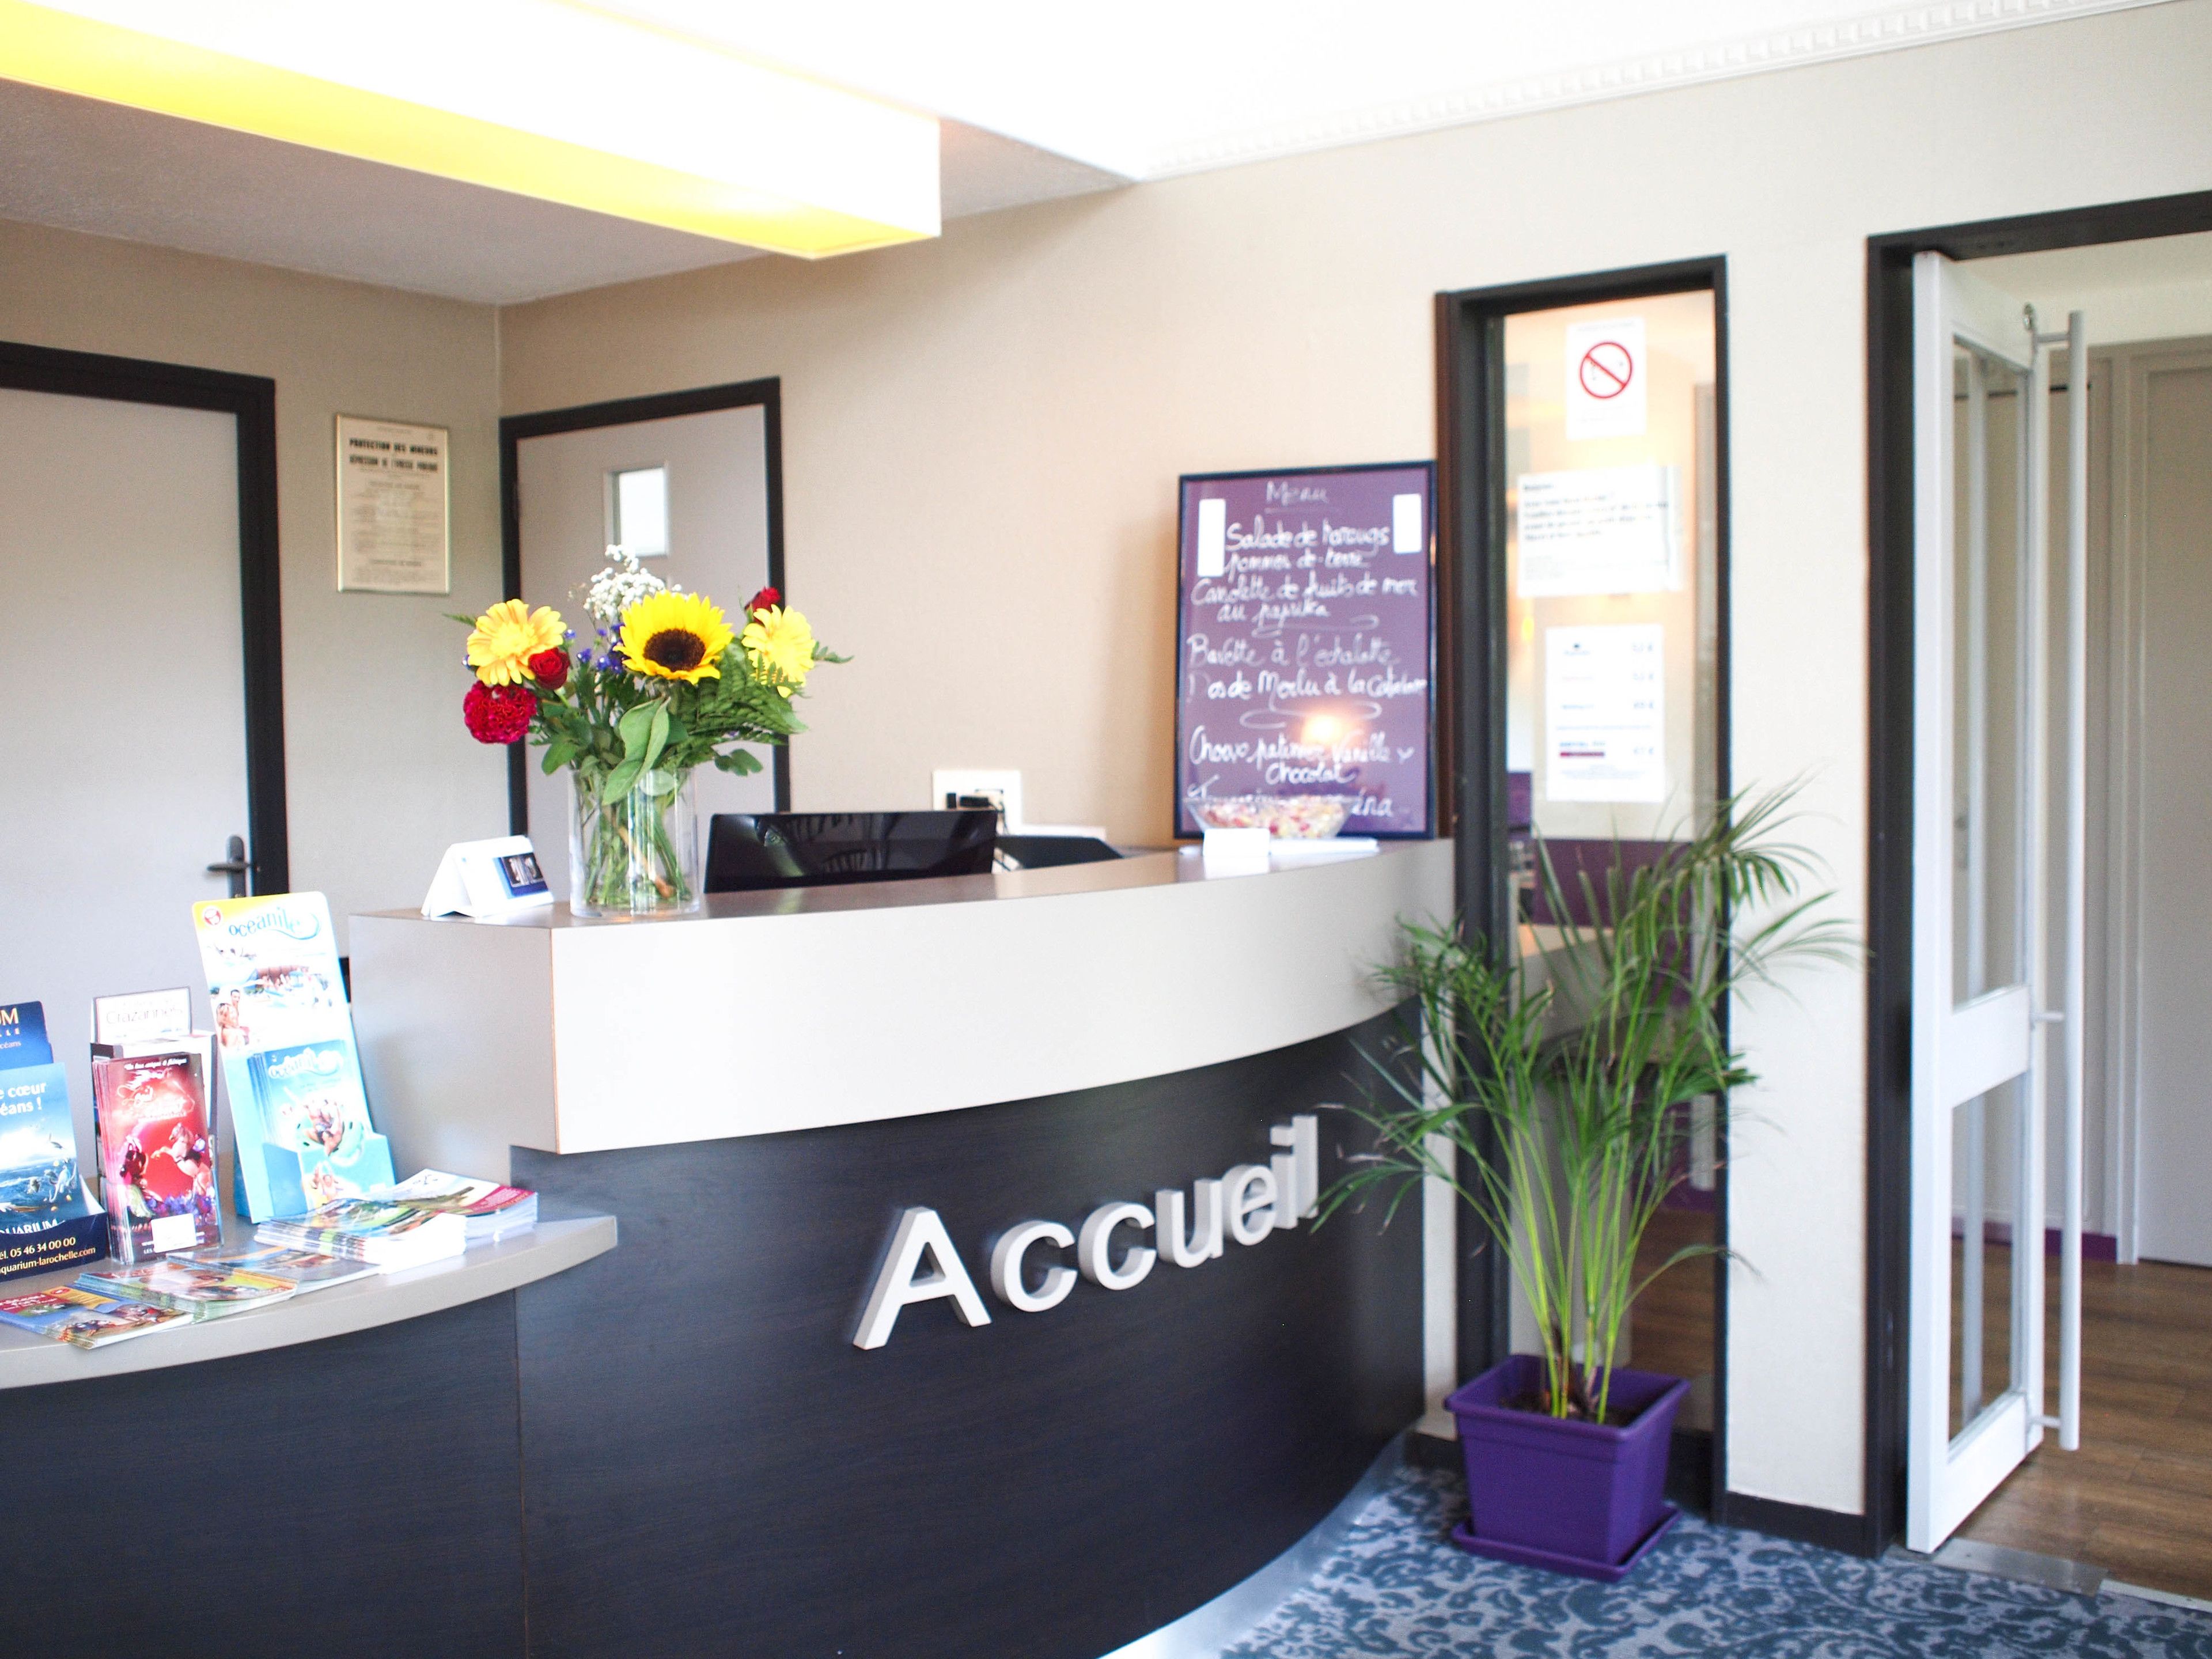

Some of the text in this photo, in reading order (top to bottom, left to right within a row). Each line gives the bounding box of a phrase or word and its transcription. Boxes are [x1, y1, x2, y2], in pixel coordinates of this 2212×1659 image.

[1225, 514, 1293, 551] Salade
[7, 1082, 46, 1098] cœur
[0, 1100, 34, 1116] éans
[853, 1115, 1319, 1350] Accueil
[10, 1248, 22, 1258] 05
[23, 1244, 35, 1255] 46
[37, 1243, 47, 1253] 34
[48, 1240, 62, 1250] 00
[63, 1237, 76, 1247] 00
[0, 1247, 96, 1275] quarium-larochelle.com
